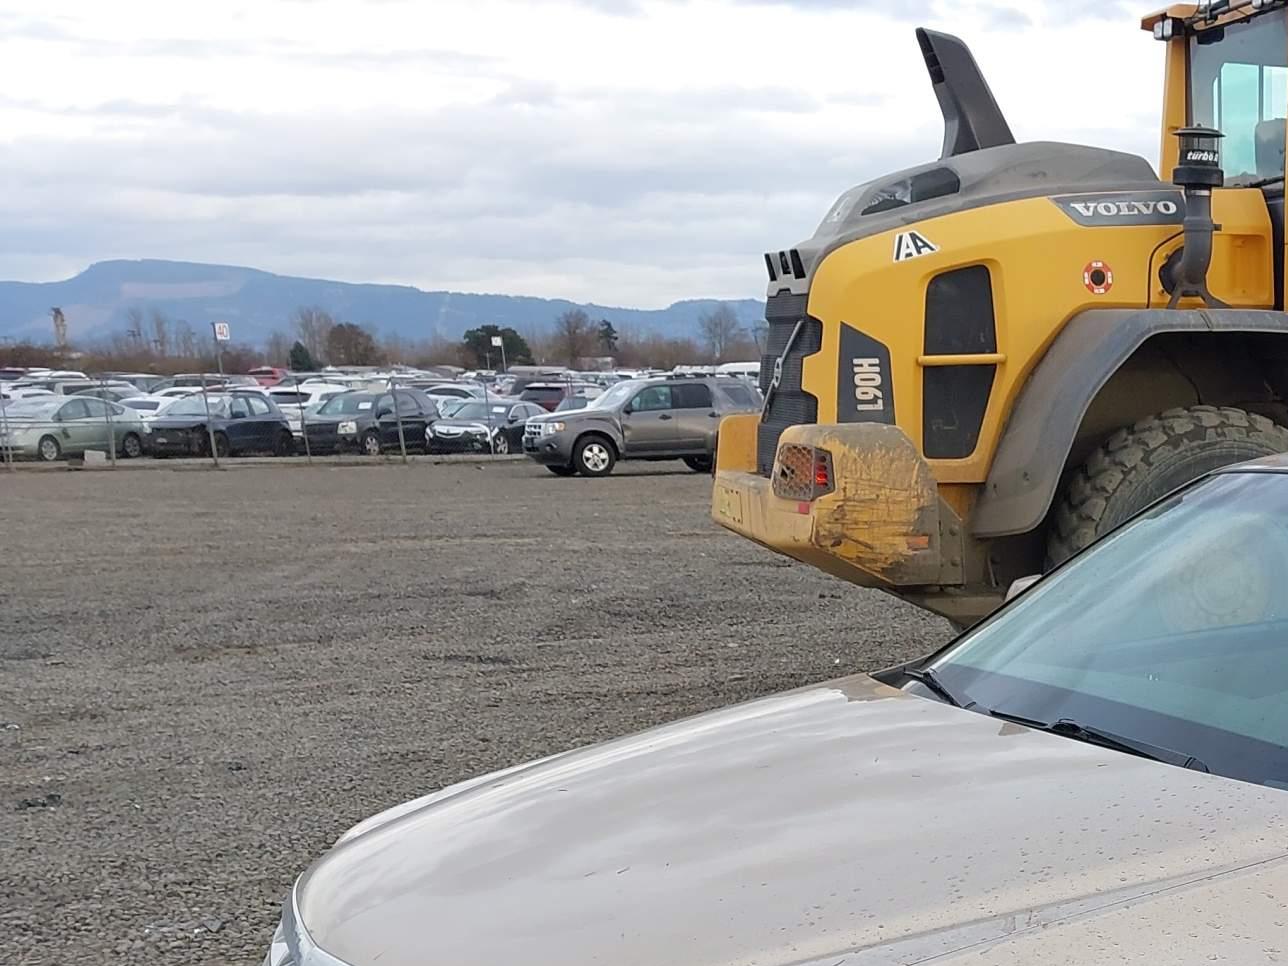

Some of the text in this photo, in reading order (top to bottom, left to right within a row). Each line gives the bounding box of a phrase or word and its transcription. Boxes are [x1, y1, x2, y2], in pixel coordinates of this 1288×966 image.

[1070, 201, 1177, 216] VOLVO
[894, 231, 937, 261] IAA
[852, 357, 884, 411] L90H
